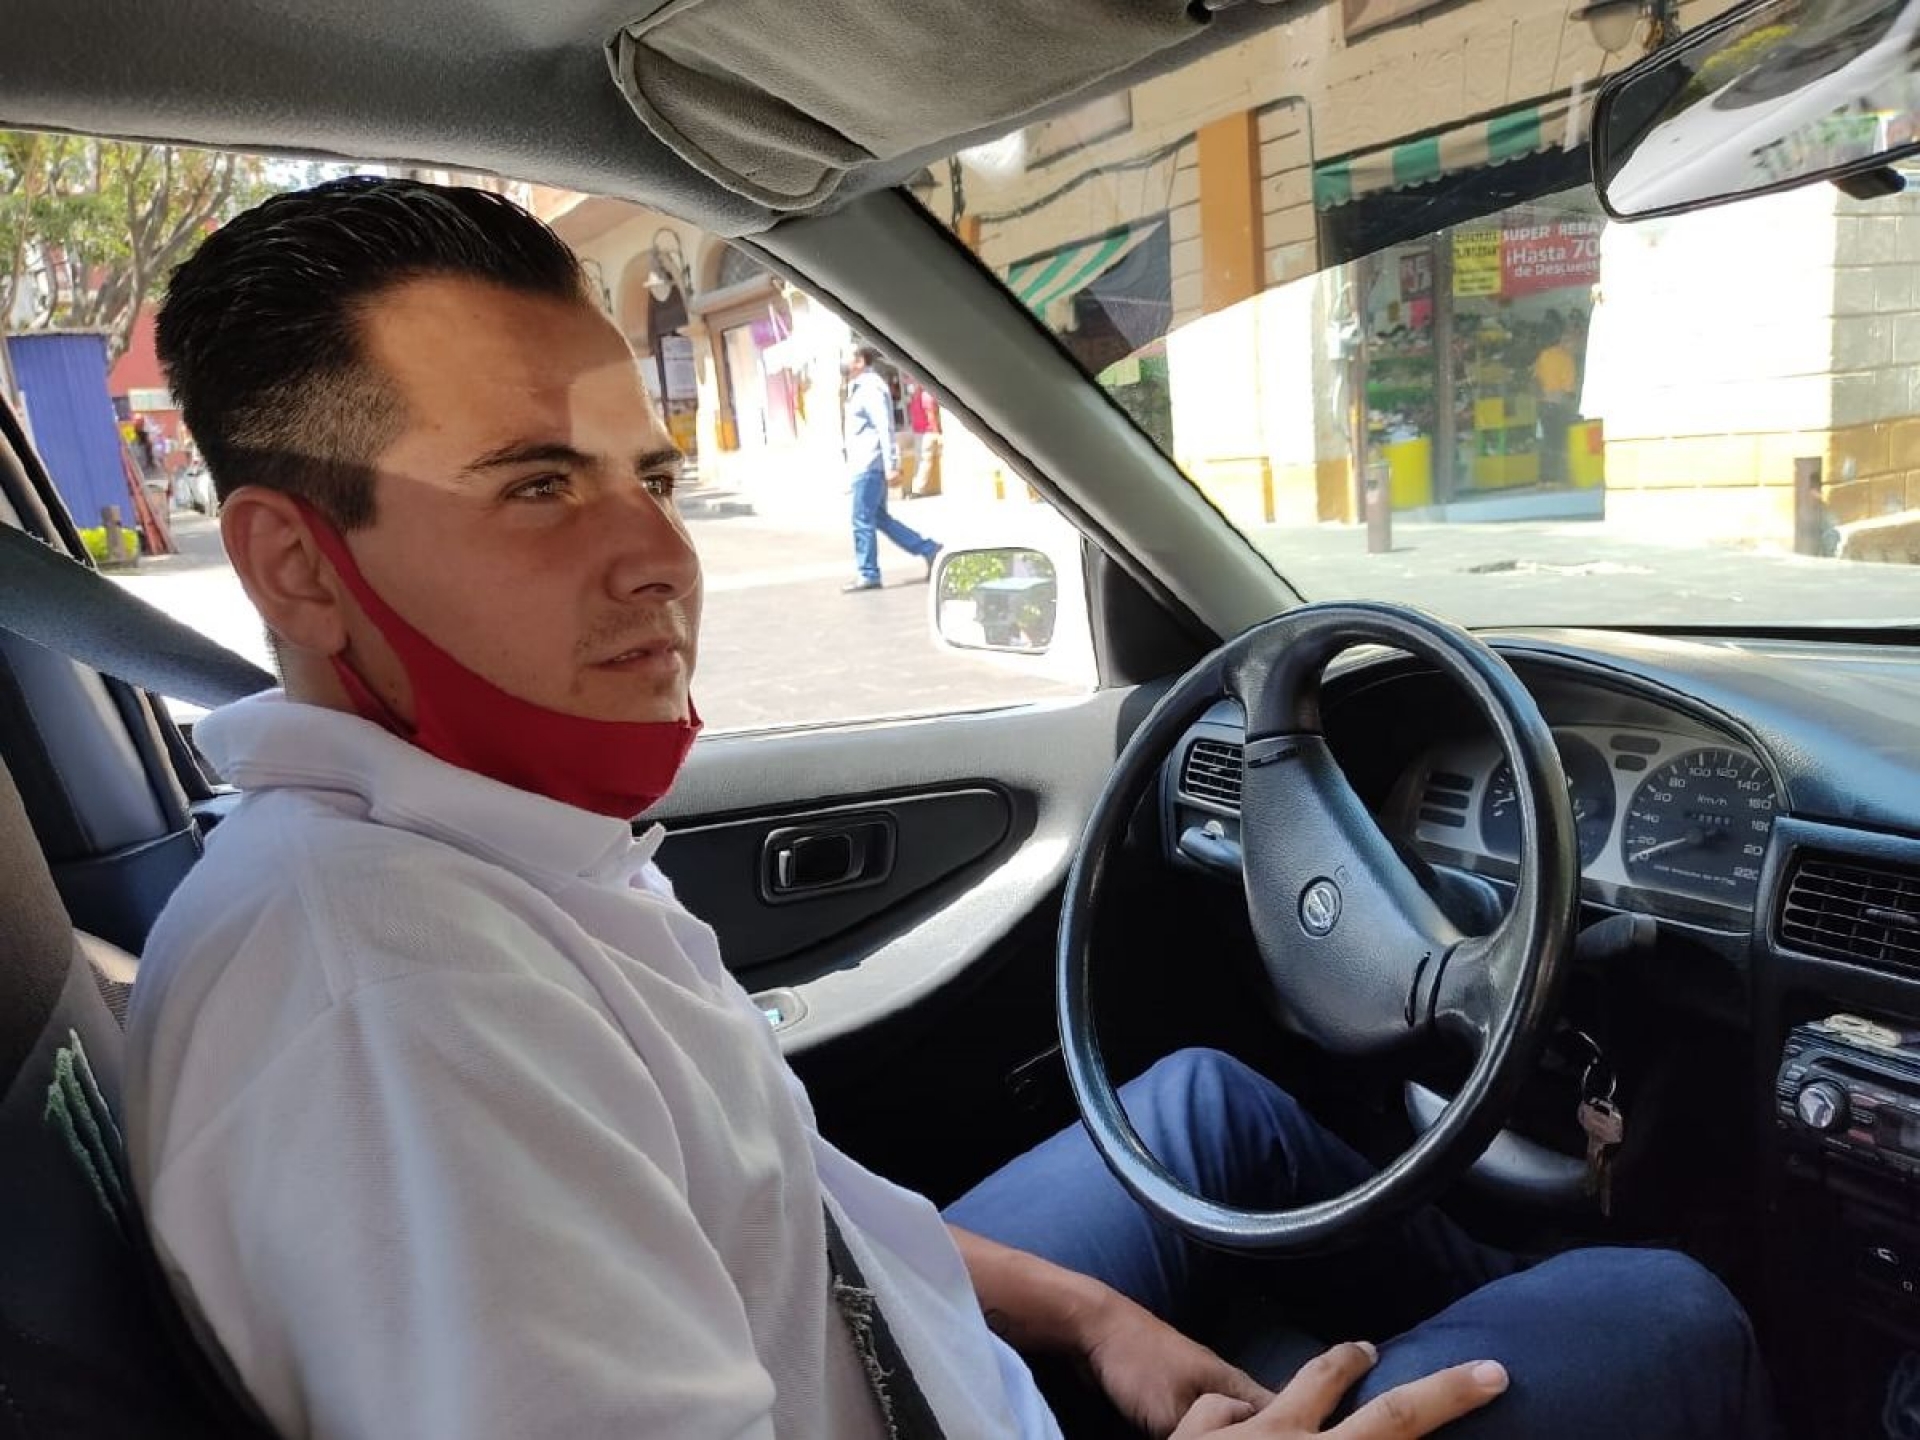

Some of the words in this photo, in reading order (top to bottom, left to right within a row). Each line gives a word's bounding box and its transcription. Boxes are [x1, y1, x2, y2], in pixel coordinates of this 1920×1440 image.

[1571, 238, 1600, 260] 70
[1689, 767, 1711, 777] 100
[1716, 767, 1738, 778] 120
[1669, 777, 1686, 788] 80
[1737, 780, 1761, 791] 140
[1642, 814, 1660, 823] 40
